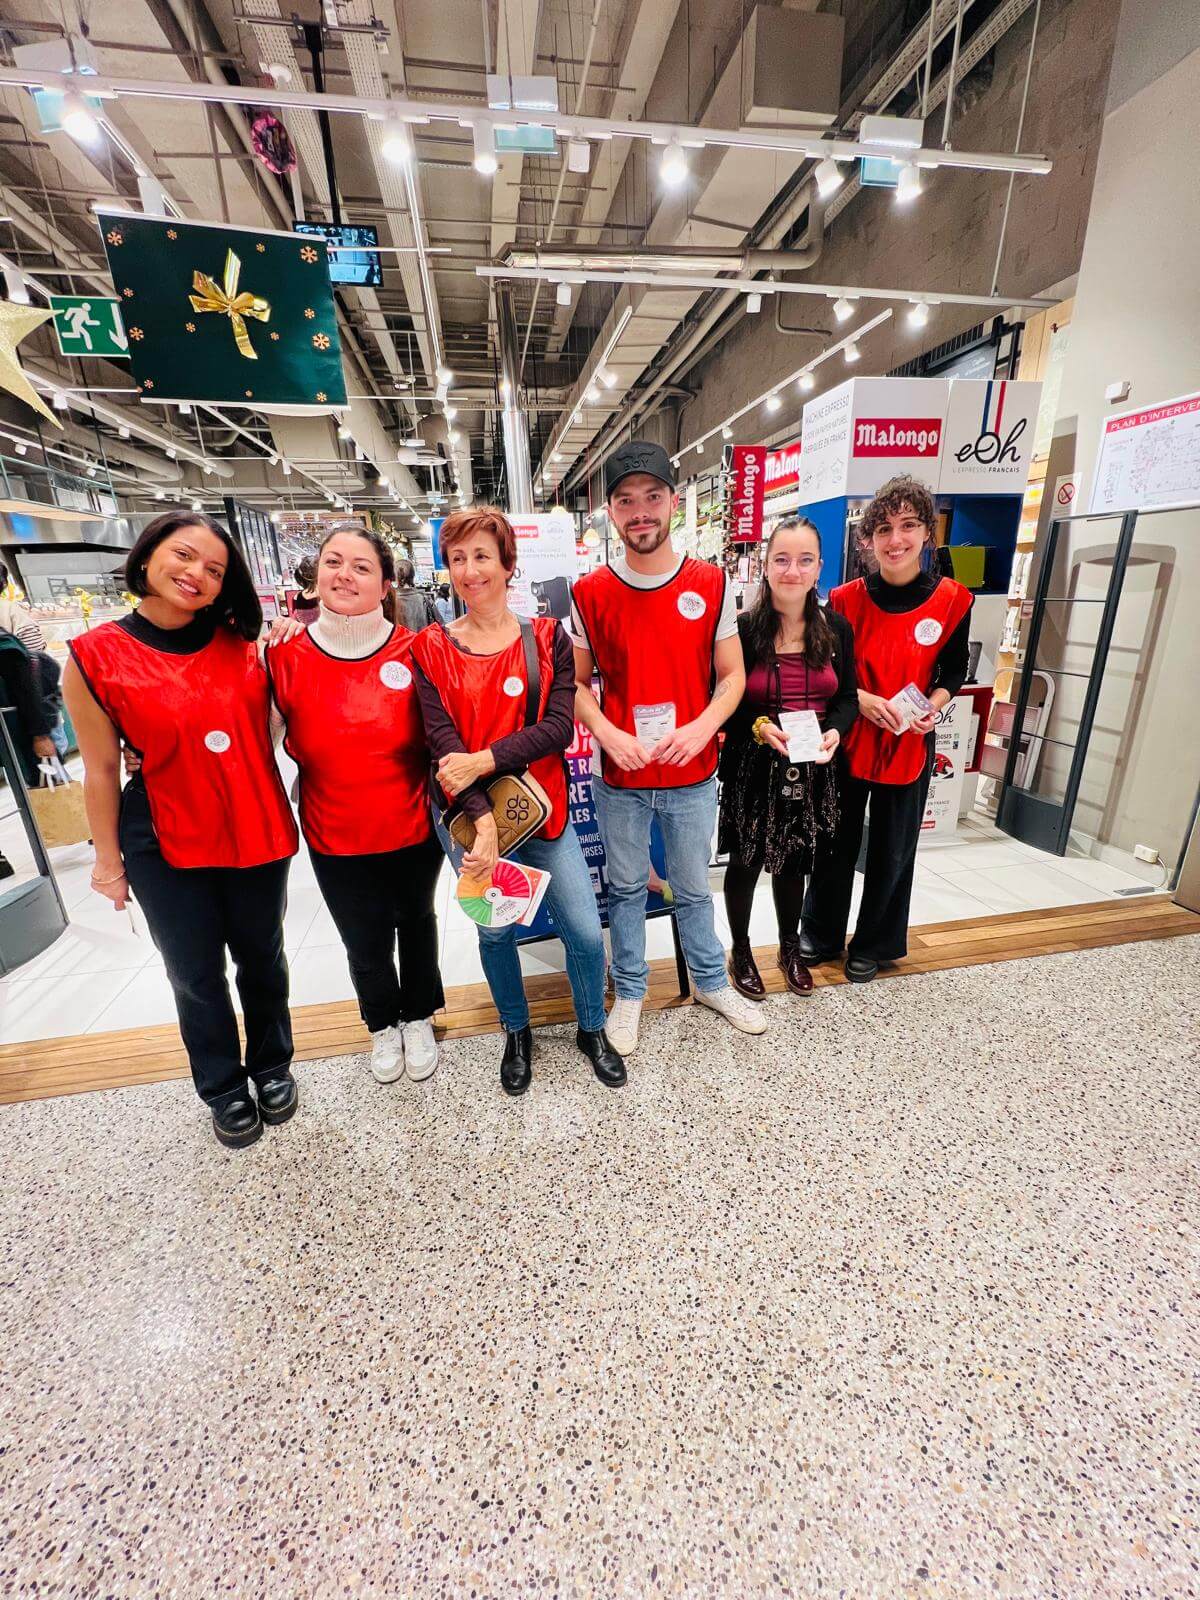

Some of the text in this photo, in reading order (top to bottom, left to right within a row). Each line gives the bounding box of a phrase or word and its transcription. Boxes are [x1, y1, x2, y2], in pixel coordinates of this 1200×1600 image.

[857, 423, 938, 453] Malongo
[1111, 418, 1136, 430] PLAN
[738, 453, 760, 535] Malongo
